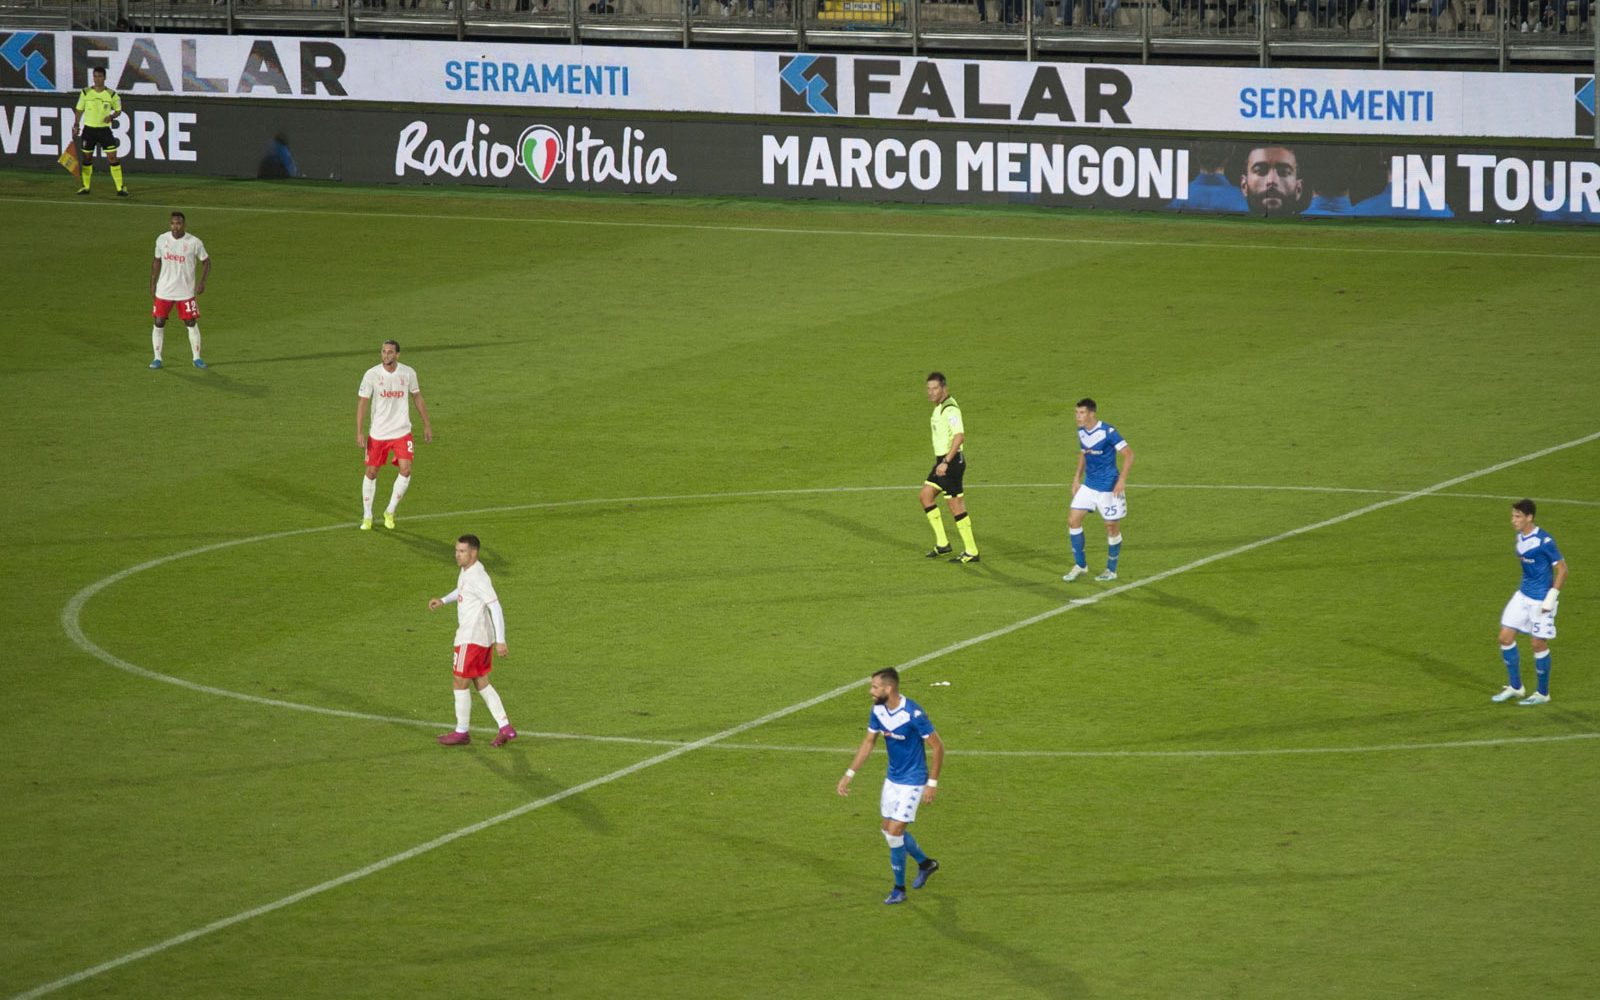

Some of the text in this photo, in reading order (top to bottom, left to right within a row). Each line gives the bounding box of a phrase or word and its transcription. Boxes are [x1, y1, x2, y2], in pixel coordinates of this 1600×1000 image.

[72, 35, 349, 96] FALAR
[445, 60, 629, 96] SERRAMENTI
[854, 58, 1133, 124] FALAR
[1239, 87, 1434, 122] SERRAMENTI
[395, 118, 677, 184] Radio Italia
[762, 135, 1600, 213] MARCO MENGONI IN TOUR
[164, 252, 186, 264] Jeep
[380, 389, 404, 399] Jeep
[1104, 505, 1118, 517] 25
